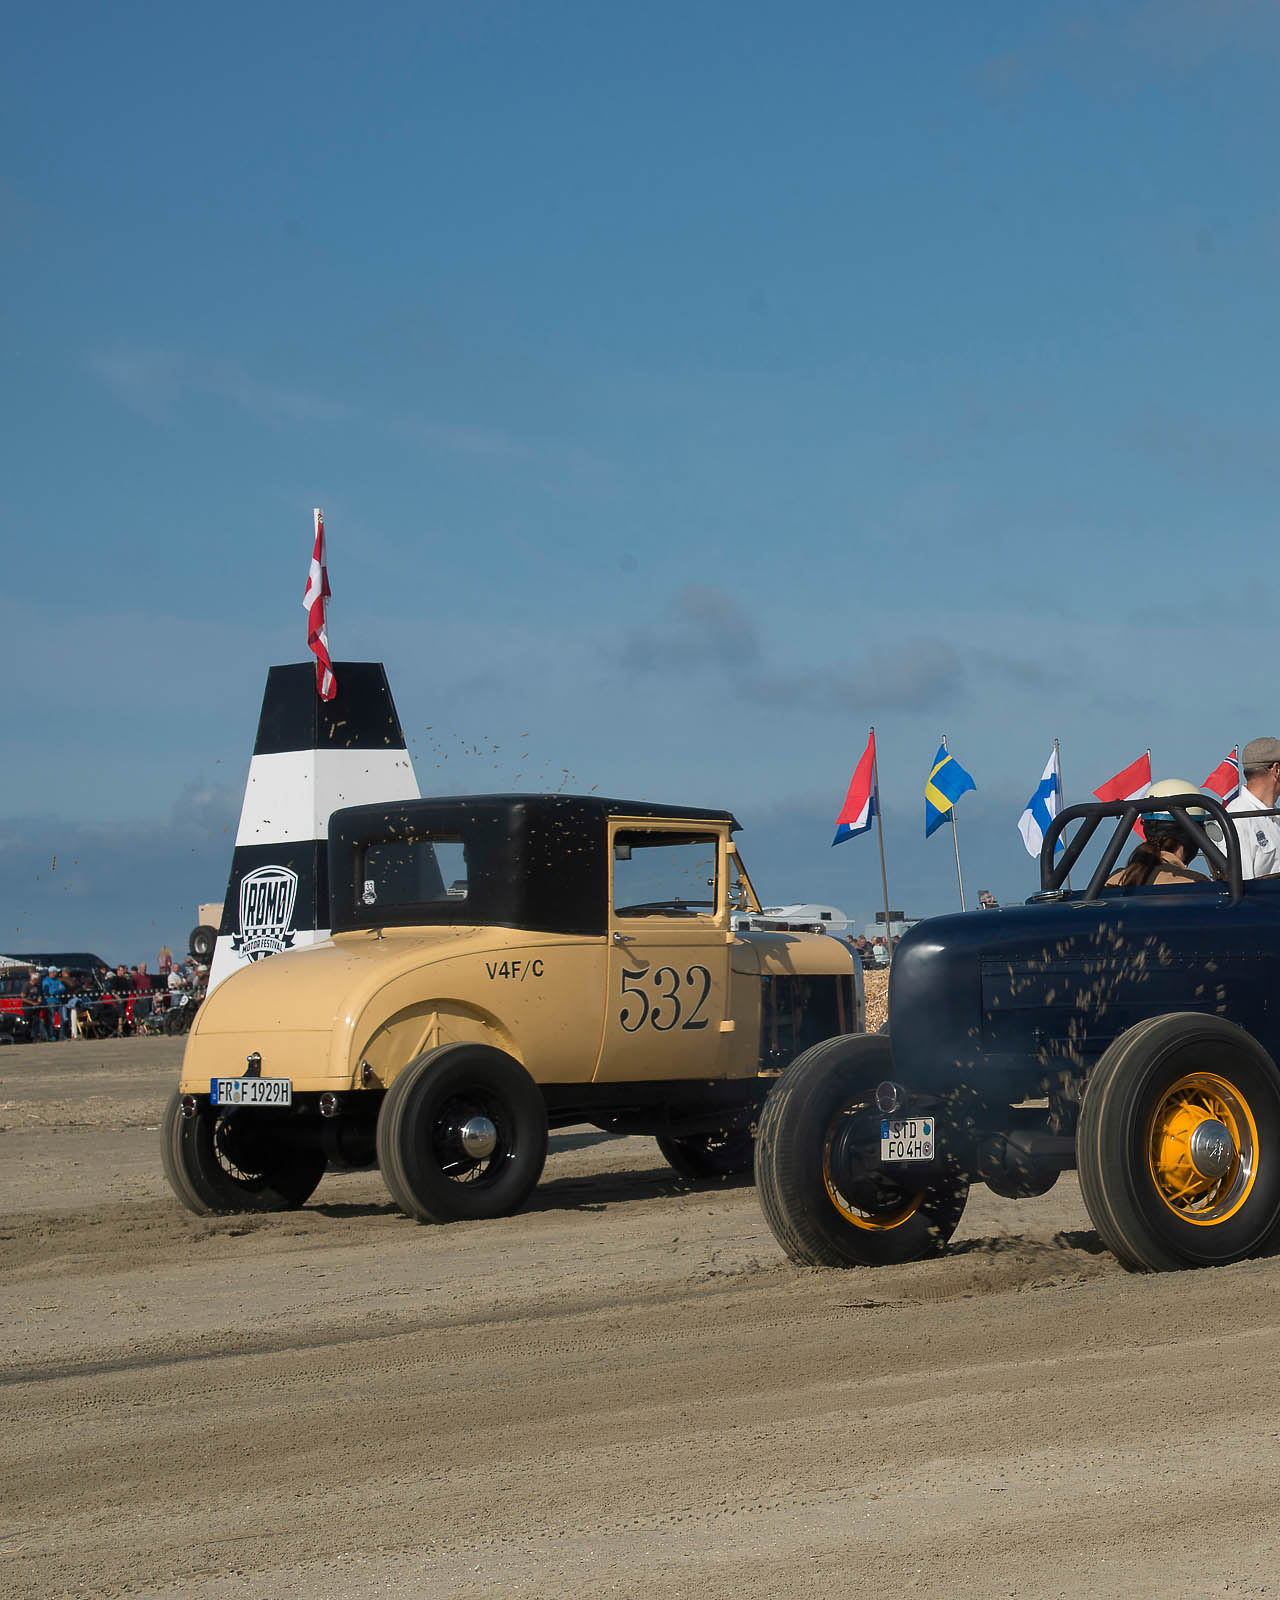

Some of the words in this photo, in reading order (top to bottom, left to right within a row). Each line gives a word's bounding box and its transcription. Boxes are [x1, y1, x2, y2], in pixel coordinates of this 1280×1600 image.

[242, 940, 261, 954] MOTOR
[260, 939, 283, 953] FESTIVAL
[485, 959, 545, 982] V4F/C
[619, 964, 712, 1033] 532
[218, 1082, 232, 1102] FR
[241, 1082, 248, 1102] F
[251, 1082, 289, 1102] 1929H
[893, 1121, 917, 1139] STD
